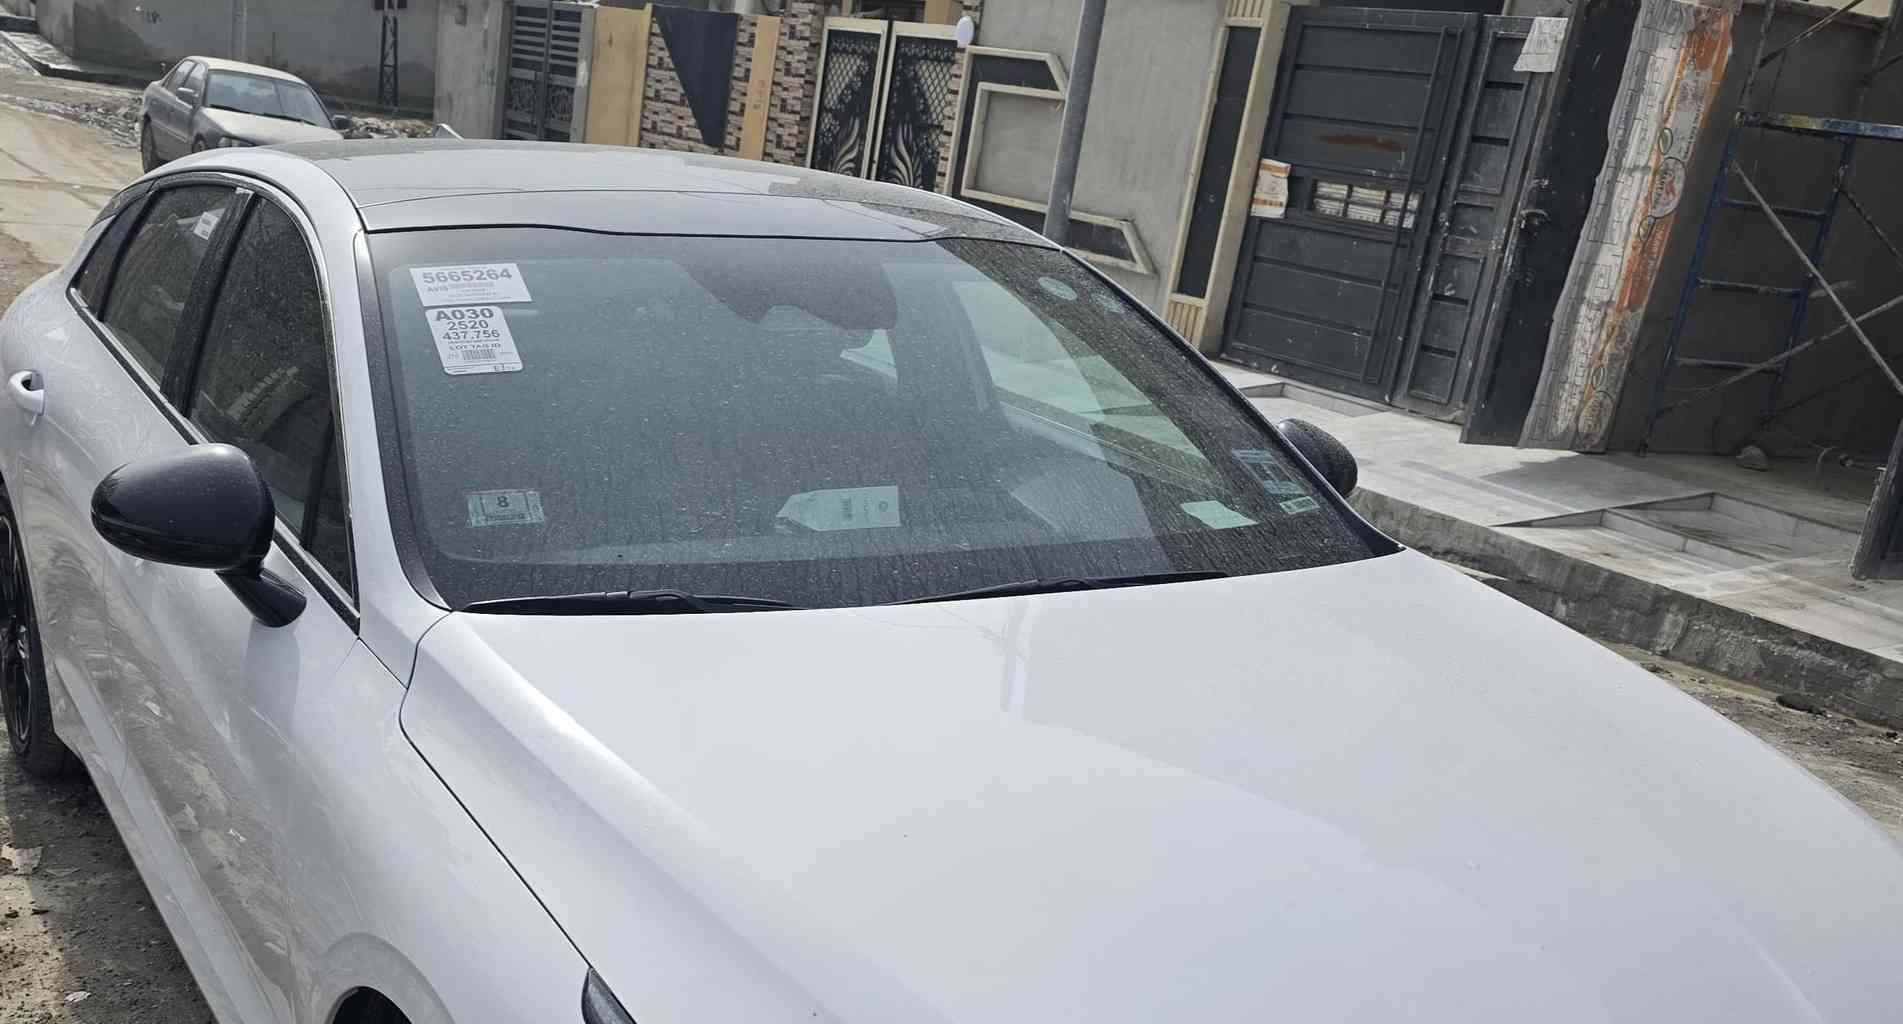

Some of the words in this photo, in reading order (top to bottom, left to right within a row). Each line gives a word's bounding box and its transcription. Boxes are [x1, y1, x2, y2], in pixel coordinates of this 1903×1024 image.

[422, 268, 512, 284] 5665264
[436, 308, 493, 321] A030
[447, 320, 489, 331] 2520
[443, 330, 500, 340] 437.756
[496, 495, 509, 508] 8
